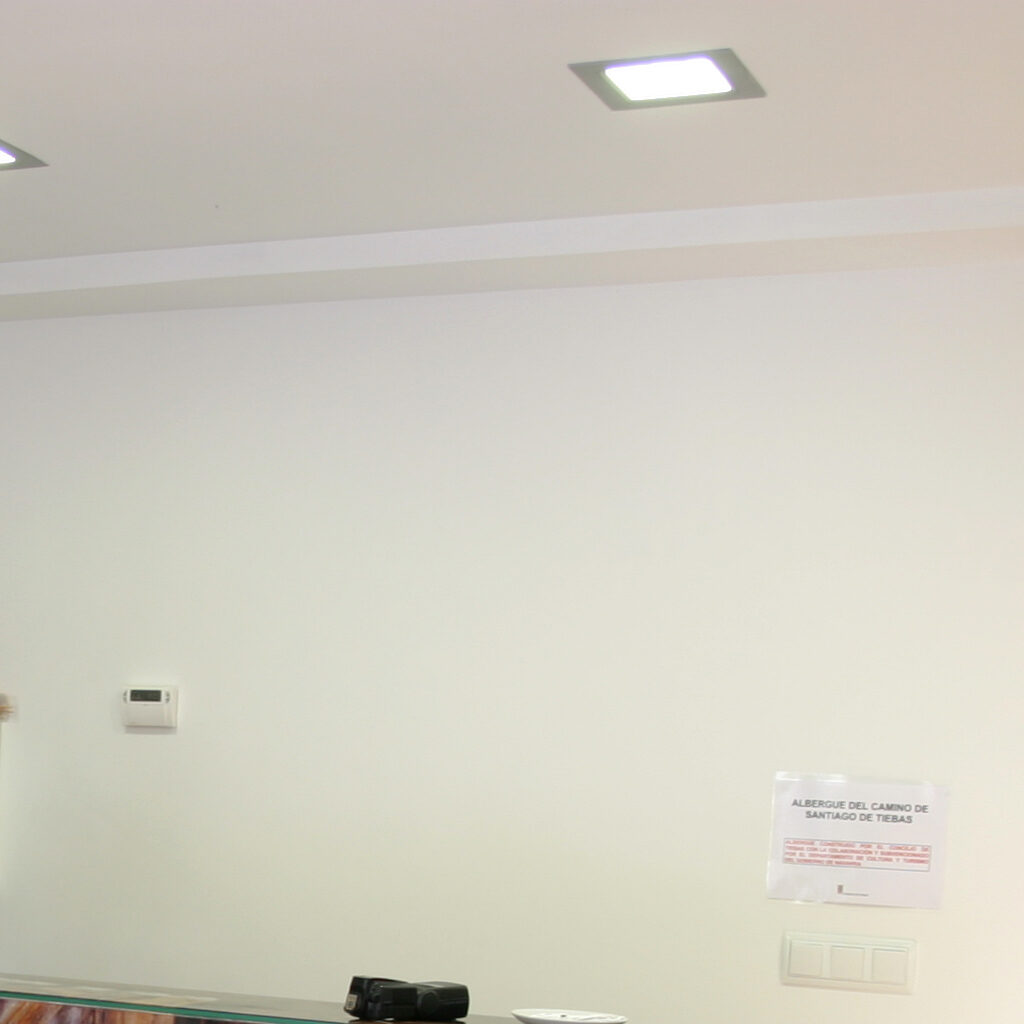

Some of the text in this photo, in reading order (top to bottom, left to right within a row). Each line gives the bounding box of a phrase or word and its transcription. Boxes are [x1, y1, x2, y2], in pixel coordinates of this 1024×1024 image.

[792, 799, 928, 813] ALBERGUE DEL CAMINO DE
[805, 811, 913, 824] SANTIAGO DE TIEBAS
